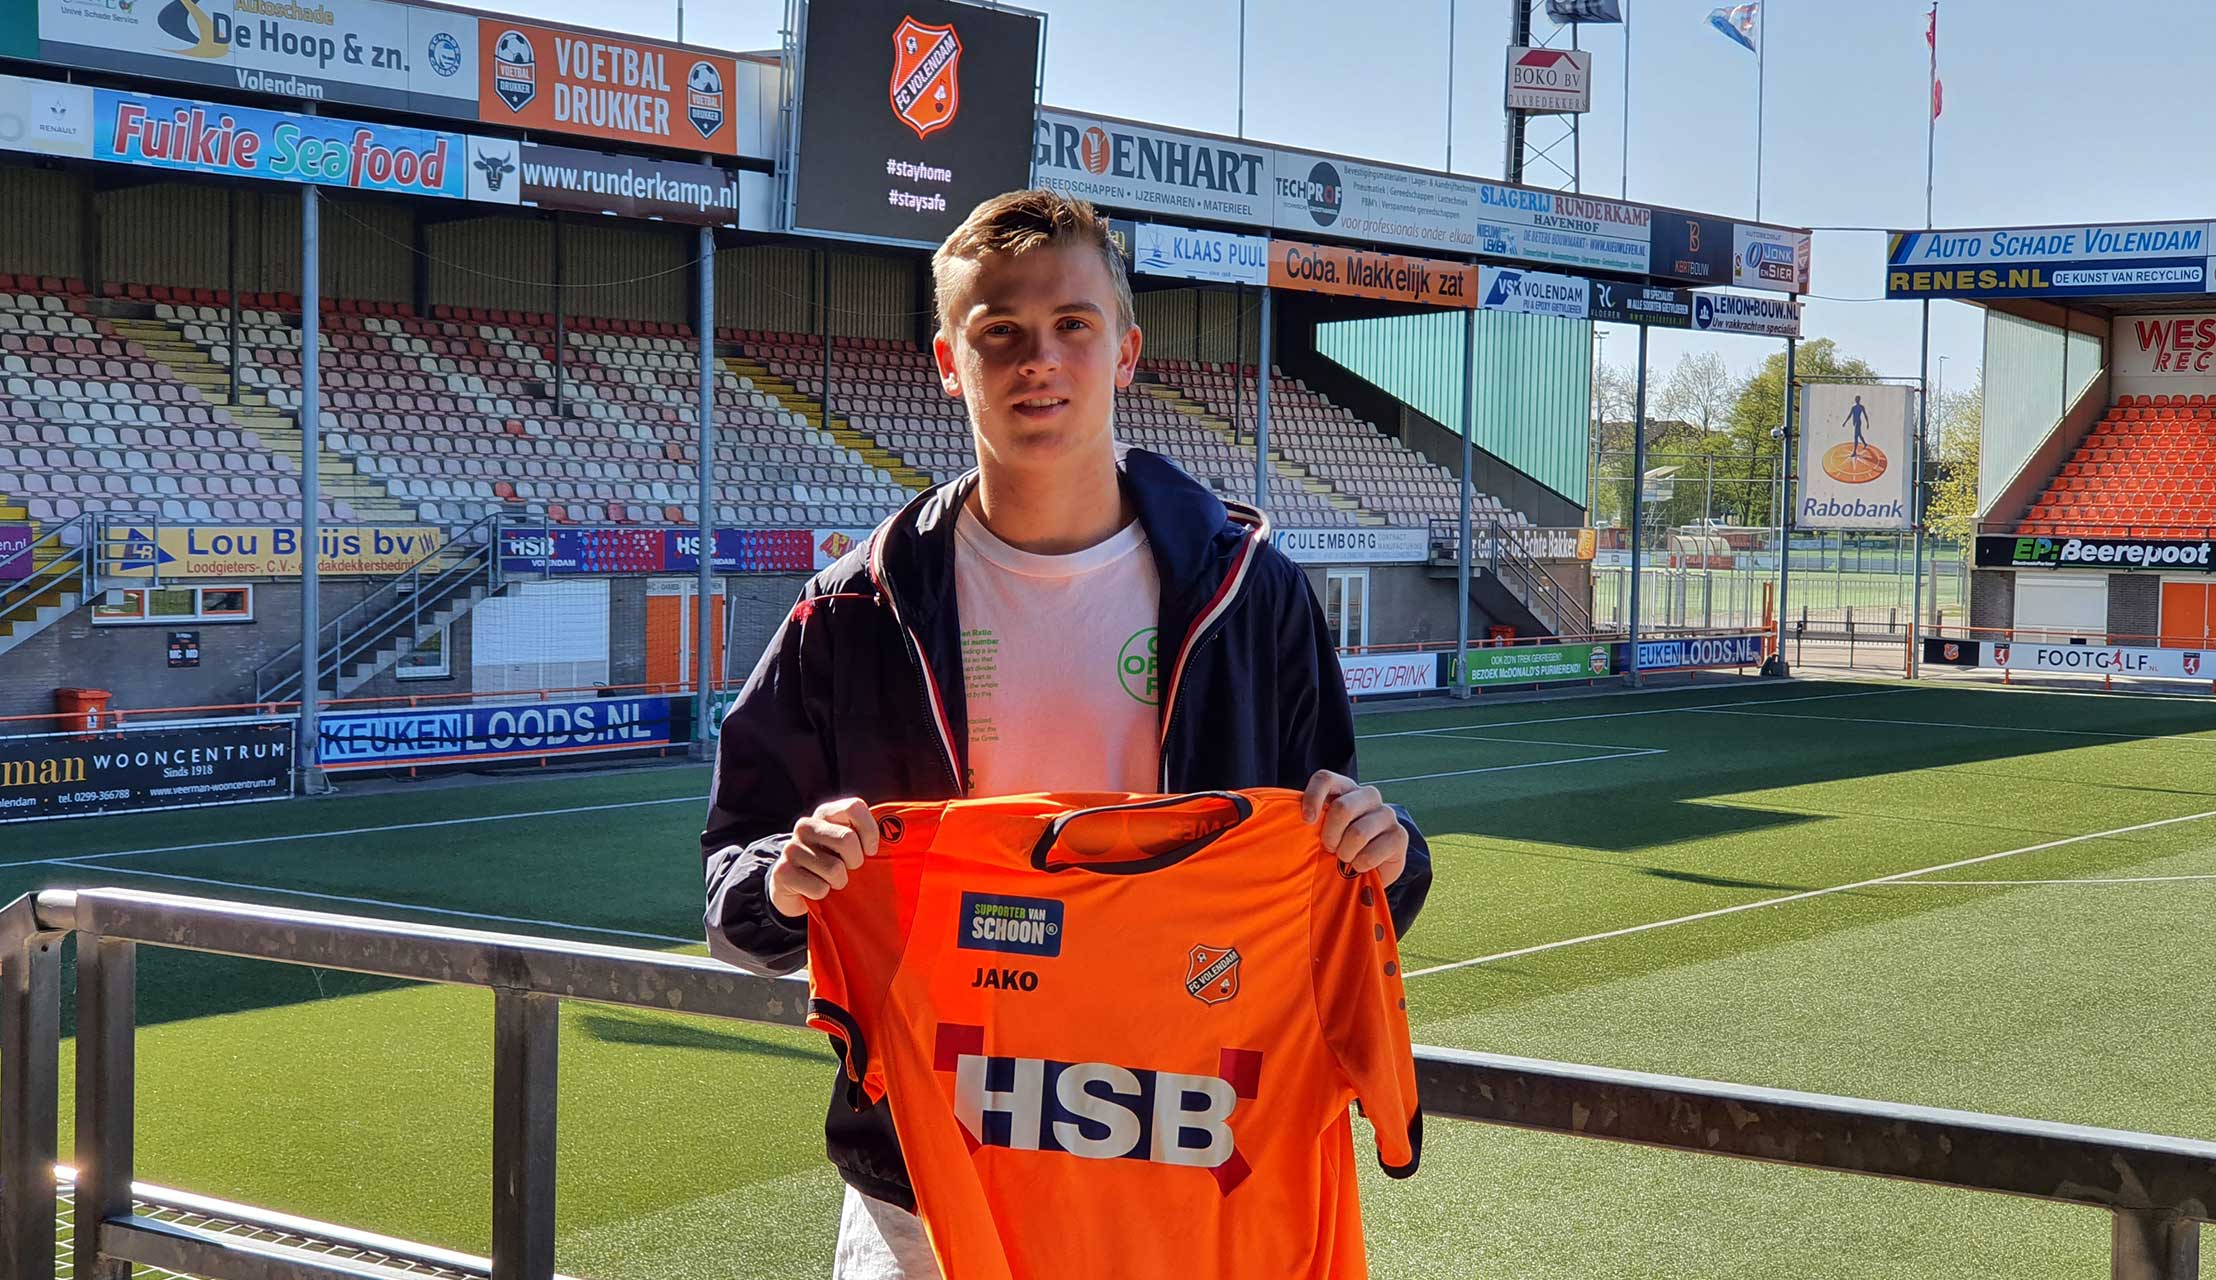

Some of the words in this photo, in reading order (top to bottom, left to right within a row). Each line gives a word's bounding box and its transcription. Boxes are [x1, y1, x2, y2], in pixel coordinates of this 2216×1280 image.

[112, 14, 138, 24] Service
[235, 0, 334, 25] Autoschade
[212, 12, 251, 48] De
[260, 19, 335, 69] Hoop
[343, 33, 364, 65] &
[371, 46, 410, 71] zn.
[554, 37, 671, 92] VOETBAL
[895, 90, 911, 111] FC
[908, 35, 957, 94] VOLENDAM
[1514, 67, 1557, 87] BOKO
[1564, 72, 1581, 88] BV
[236, 68, 324, 99] Volendam
[554, 83, 671, 136] DRUKKER
[1508, 94, 1586, 112] DAKBEDEKKERS
[39, 124, 76, 135] RENAULT
[113, 102, 260, 170] Fuikie
[269, 121, 449, 190] Seafood
[886, 158, 952, 184] #stayhome
[522, 160, 738, 210] www.runderkamp.nl
[1036, 175, 1124, 199] EREEDSCHAPPEN
[1135, 190, 1195, 209] IJZERWAREN
[1203, 200, 1253, 216] MATERIEEL
[1276, 177, 1341, 205] TECHPROF
[888, 189, 946, 213] #staysafe
[1480, 185, 1551, 214] SLAGERIJ
[1554, 196, 1650, 228] RUNDERKAMP
[1362, 218, 1419, 238] professionals
[1421, 227, 1445, 241] onder
[1449, 228, 1475, 245] elkaar
[1534, 214, 1600, 233] HAVENHOF
[1173, 236, 1222, 263] KLAAS
[1229, 242, 1265, 268] PUUL
[1764, 244, 1793, 262] JONK
[1925, 234, 1982, 258] AUTO
[1990, 232, 2076, 257] SCHADE
[2084, 228, 2202, 254] VOLENDAM
[1286, 247, 1340, 284] Coba.
[1347, 256, 1431, 300] Makkelijk
[1439, 271, 1464, 298] zat
[1890, 269, 2049, 291] RENES.NL
[2056, 272, 2070, 284] DE
[2072, 271, 2109, 284] KUNST
[2110, 270, 2134, 283] VAN
[2136, 269, 2200, 282] RECYCLING
[1498, 278, 1521, 296] VSK
[1524, 282, 1583, 302] VOLENDAM
[1714, 296, 1799, 320] LEMON-BOUW.NL
[1766, 322, 1797, 335] specialist
[2155, 352, 2211, 373] REC
[1803, 498, 1903, 518] Rabobank
[187, 528, 257, 556] Lou
[273, 529, 360, 559] Bijs
[374, 529, 414, 556] bv
[1287, 533, 1376, 549] CULEMBORG
[1548, 530, 1577, 558] Bakker
[2060, 539, 2211, 567] Beerepoot
[1384, 664, 1431, 688] DRINK
[1472, 668, 1498, 680] BEZOEK
[1, 756, 86, 787] man
[93, 742, 285, 770] WOONCENTRUM
[163, 767, 189, 778] Sinds
[191, 764, 213, 777] 1918
[58, 792, 72, 803] tel.
[74, 789, 130, 802] 0299-366788
[150, 777, 276, 797] www.veerman-wooncentrum.nl
[974, 904, 1025, 919] SUPPORTER
[1028, 908, 1046, 920] VAN
[971, 968, 1039, 992] JAKO
[1188, 981, 1200, 993] FC
[1198, 951, 1239, 984] VOLENDAM
[954, 1054, 1237, 1168] HSB
